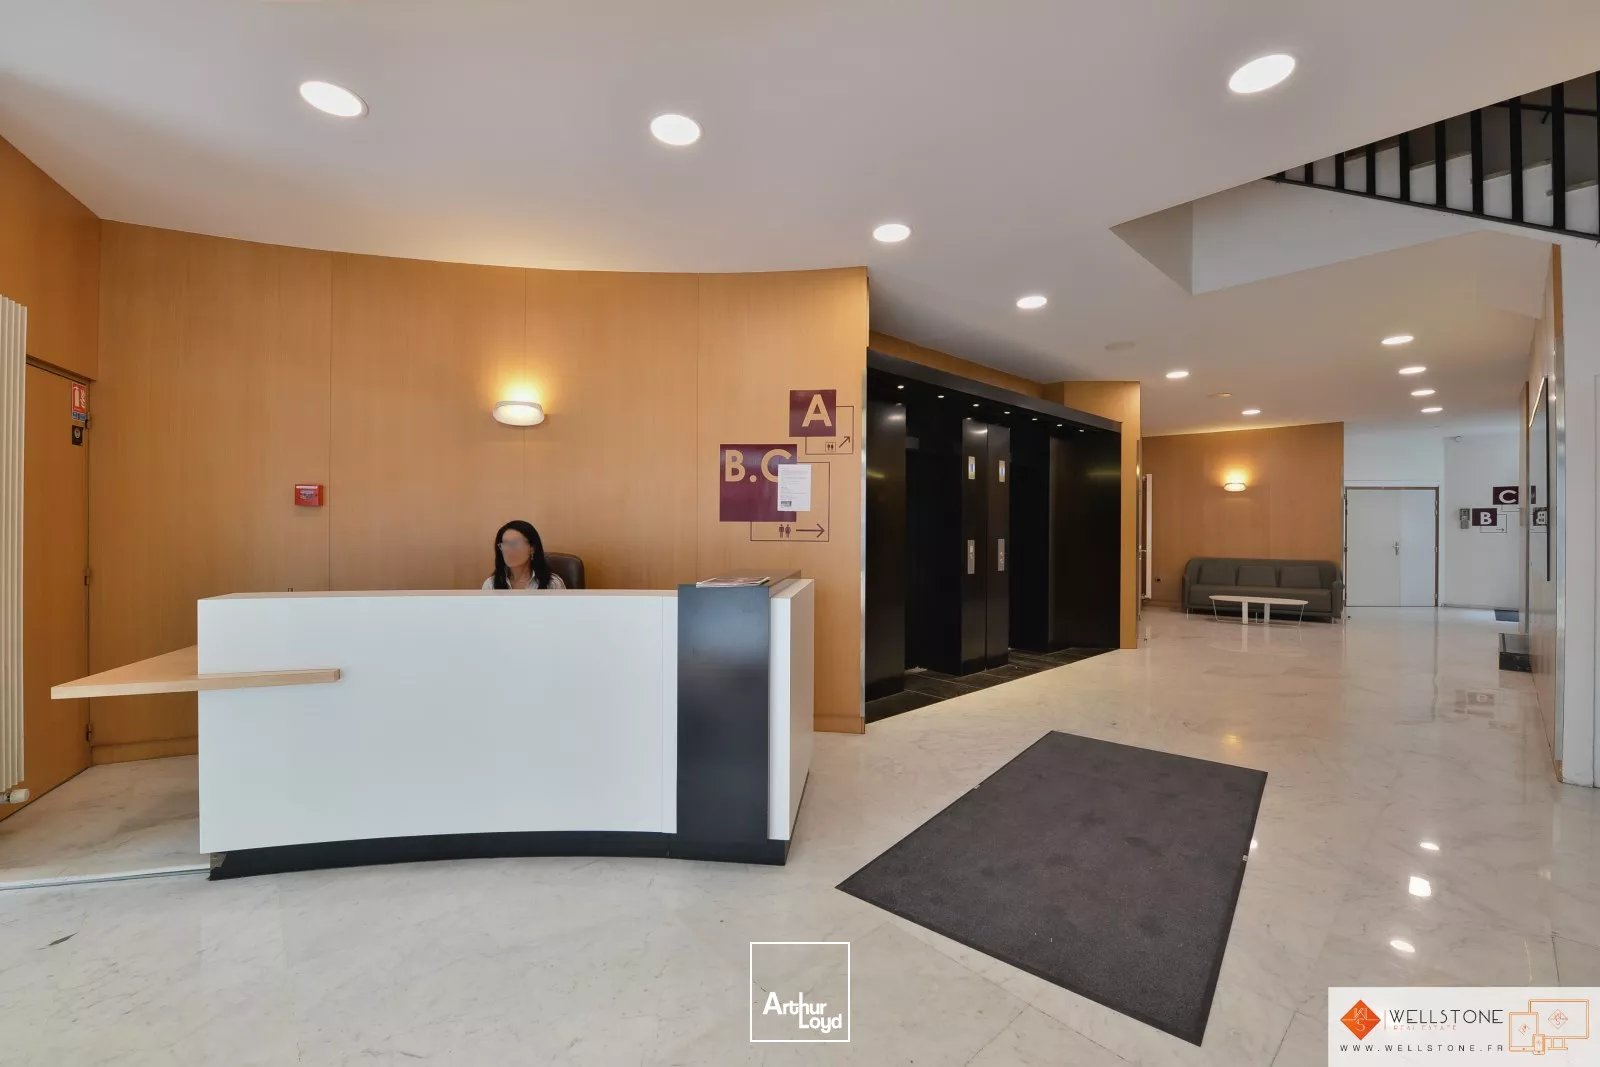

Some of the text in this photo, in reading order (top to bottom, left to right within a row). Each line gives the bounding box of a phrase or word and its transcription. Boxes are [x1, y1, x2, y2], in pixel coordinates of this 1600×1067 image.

[801, 394, 833, 427] A
[725, 449, 793, 483] B.C
[1498, 489, 1517, 504] C
[1480, 511, 1493, 525] B
